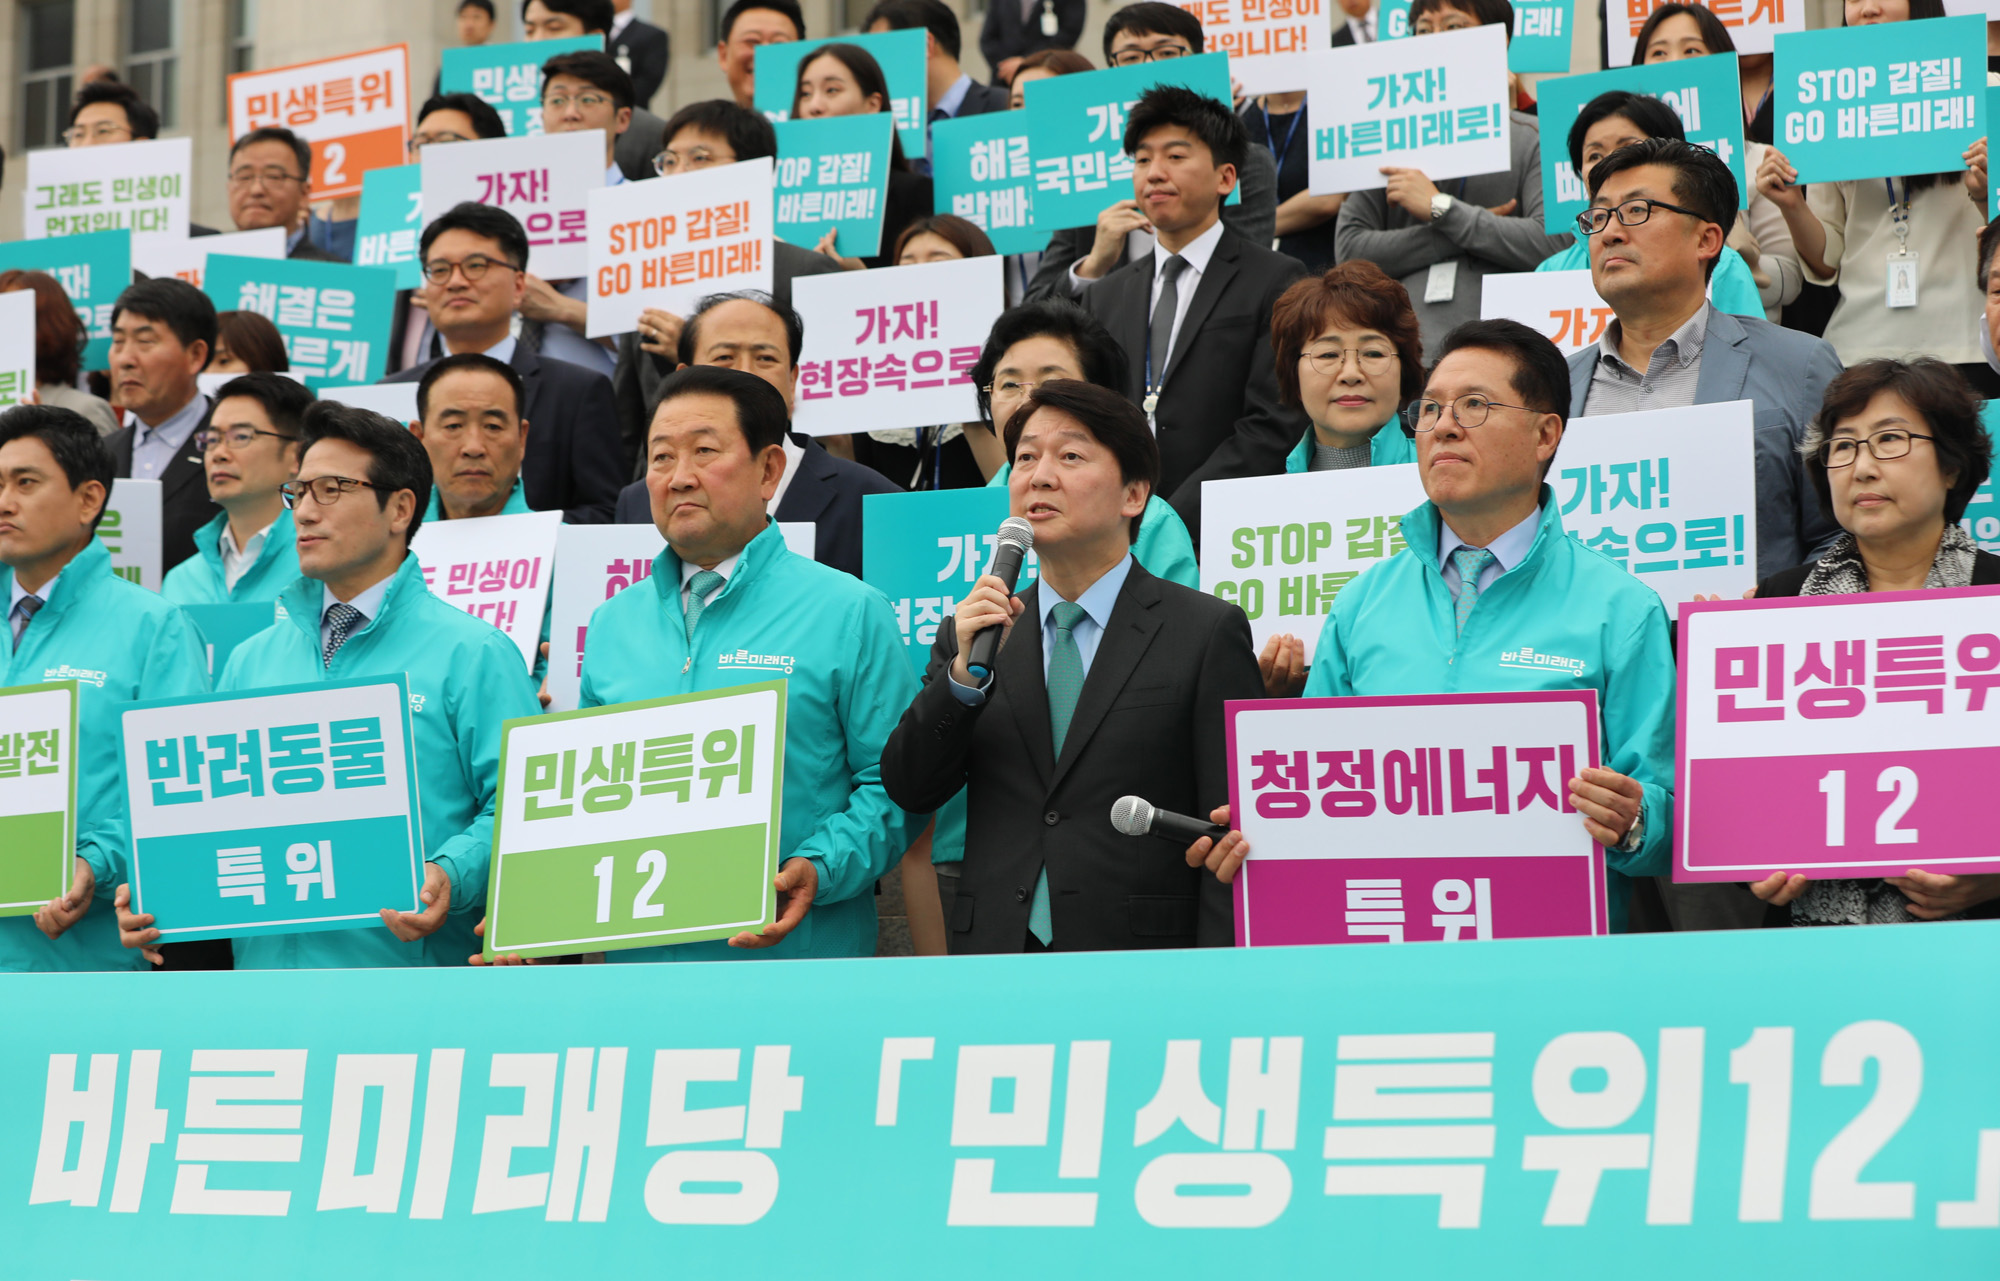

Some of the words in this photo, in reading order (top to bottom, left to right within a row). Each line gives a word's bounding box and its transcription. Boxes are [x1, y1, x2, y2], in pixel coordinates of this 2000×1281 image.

[247, 69, 393, 132] 민생특위
[1367, 66, 1447, 111] 가자!
[1797, 66, 1877, 104] STOP
[1888, 57, 1963, 96] 갑질!
[1315, 103, 1502, 162] 바른미래로!
[1785, 111, 1825, 144] GO
[1837, 95, 1976, 140] 바른미래!
[35, 181, 103, 211] 그래도
[112, 173, 181, 204] 민생이
[477, 169, 549, 205] 가자!
[818, 151, 872, 186] 갑질!
[610, 215, 677, 255] STOP
[686, 200, 751, 244] 갑질!
[777, 188, 877, 224] 바른미래!
[597, 263, 632, 298] GO
[641, 239, 762, 291] 바른미래!
[238, 280, 356, 332] 해결은
[855, 300, 939, 346] 가자!
[281, 333, 371, 383] 르게
[800, 345, 983, 401] 현장속으로
[1561, 457, 1670, 518] 가자!
[1231, 521, 1332, 569] STOP
[447, 556, 542, 596] 민생이
[44, 664, 107, 688] 바른미래당
[717, 649, 797, 676] 바른미래당
[1500, 646, 1587, 678] 바른미래당
[145, 716, 388, 807] 반려동물
[523, 723, 757, 822] 민생특위
[1250, 744, 1579, 820] 청정에너지
[29, 1042, 805, 1226] 바른미래당
